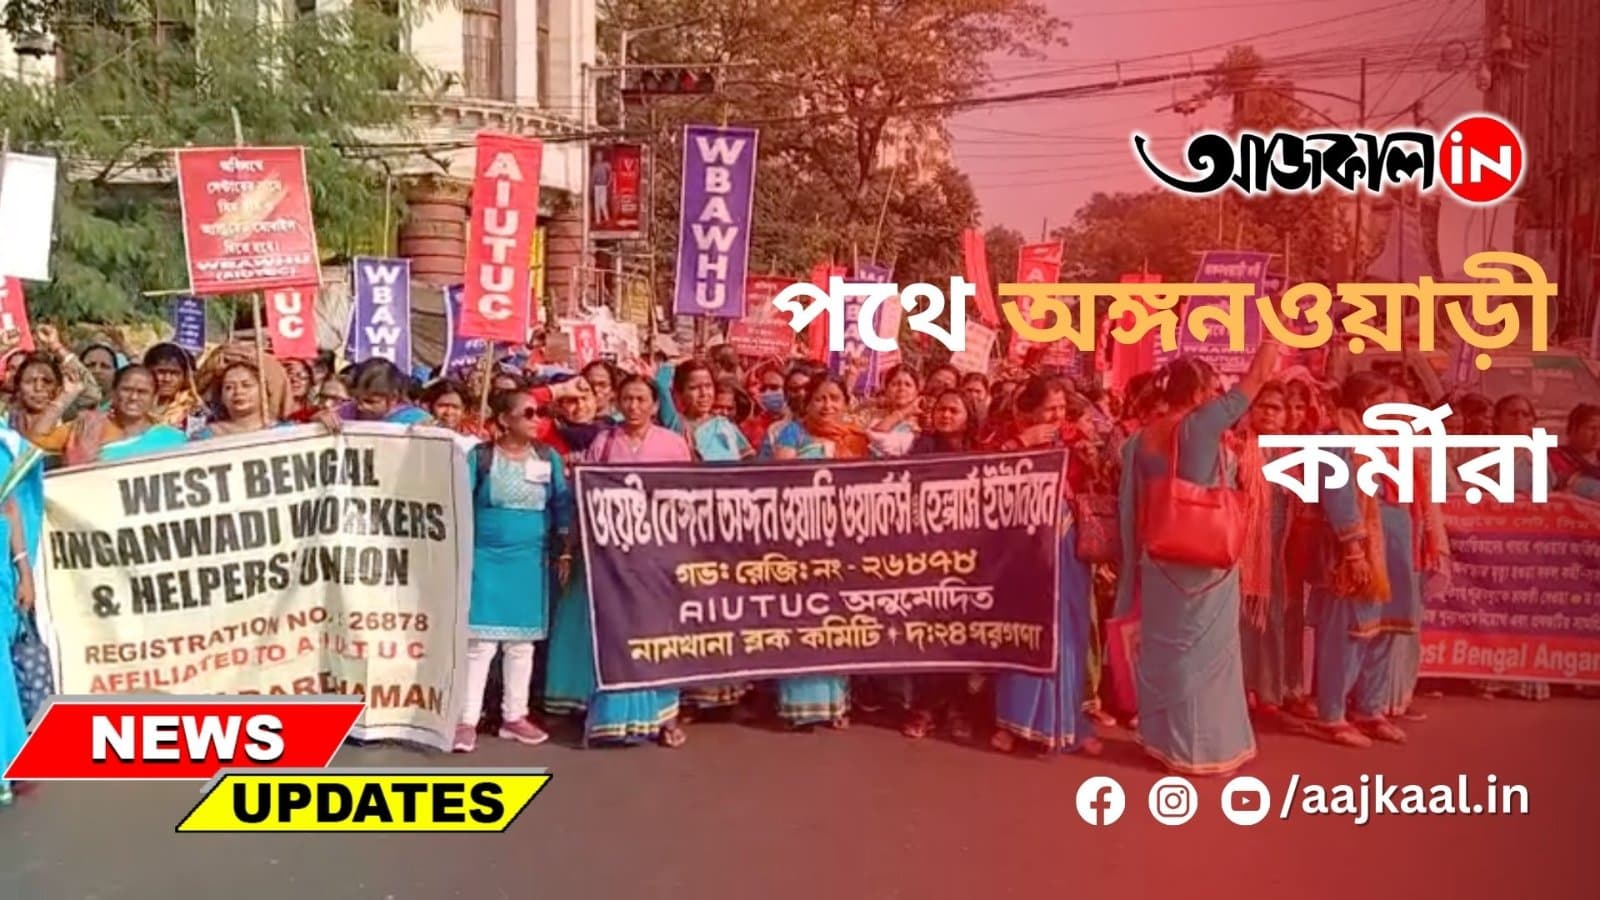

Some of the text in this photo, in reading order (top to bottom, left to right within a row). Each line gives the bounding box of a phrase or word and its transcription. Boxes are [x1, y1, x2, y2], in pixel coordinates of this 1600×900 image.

[477, 152, 524, 320] AIUTUC
[692, 136, 746, 309] WBAWHU
[363, 265, 401, 362] WBAWH
[118, 447, 379, 516] WEST BENGAL
[49, 496, 446, 570] ANGANWADI WORKERS
[91, 584, 121, 618] &
[299, 544, 409, 586] UNION
[862, 548, 978, 580] ২৬৮৭৮
[679, 576, 995, 625] AIUTUC অনুমোদিত
[85, 616, 281, 664] REGISTRATION
[349, 611, 429, 632] 26878
[628, 631, 734, 664] নামখানা
[797, 614, 884, 649] কমিটি
[1452, 639, 1528, 673] Bengal
[90, 647, 248, 694] AFFILIATED
[256, 644, 286, 664] TO
